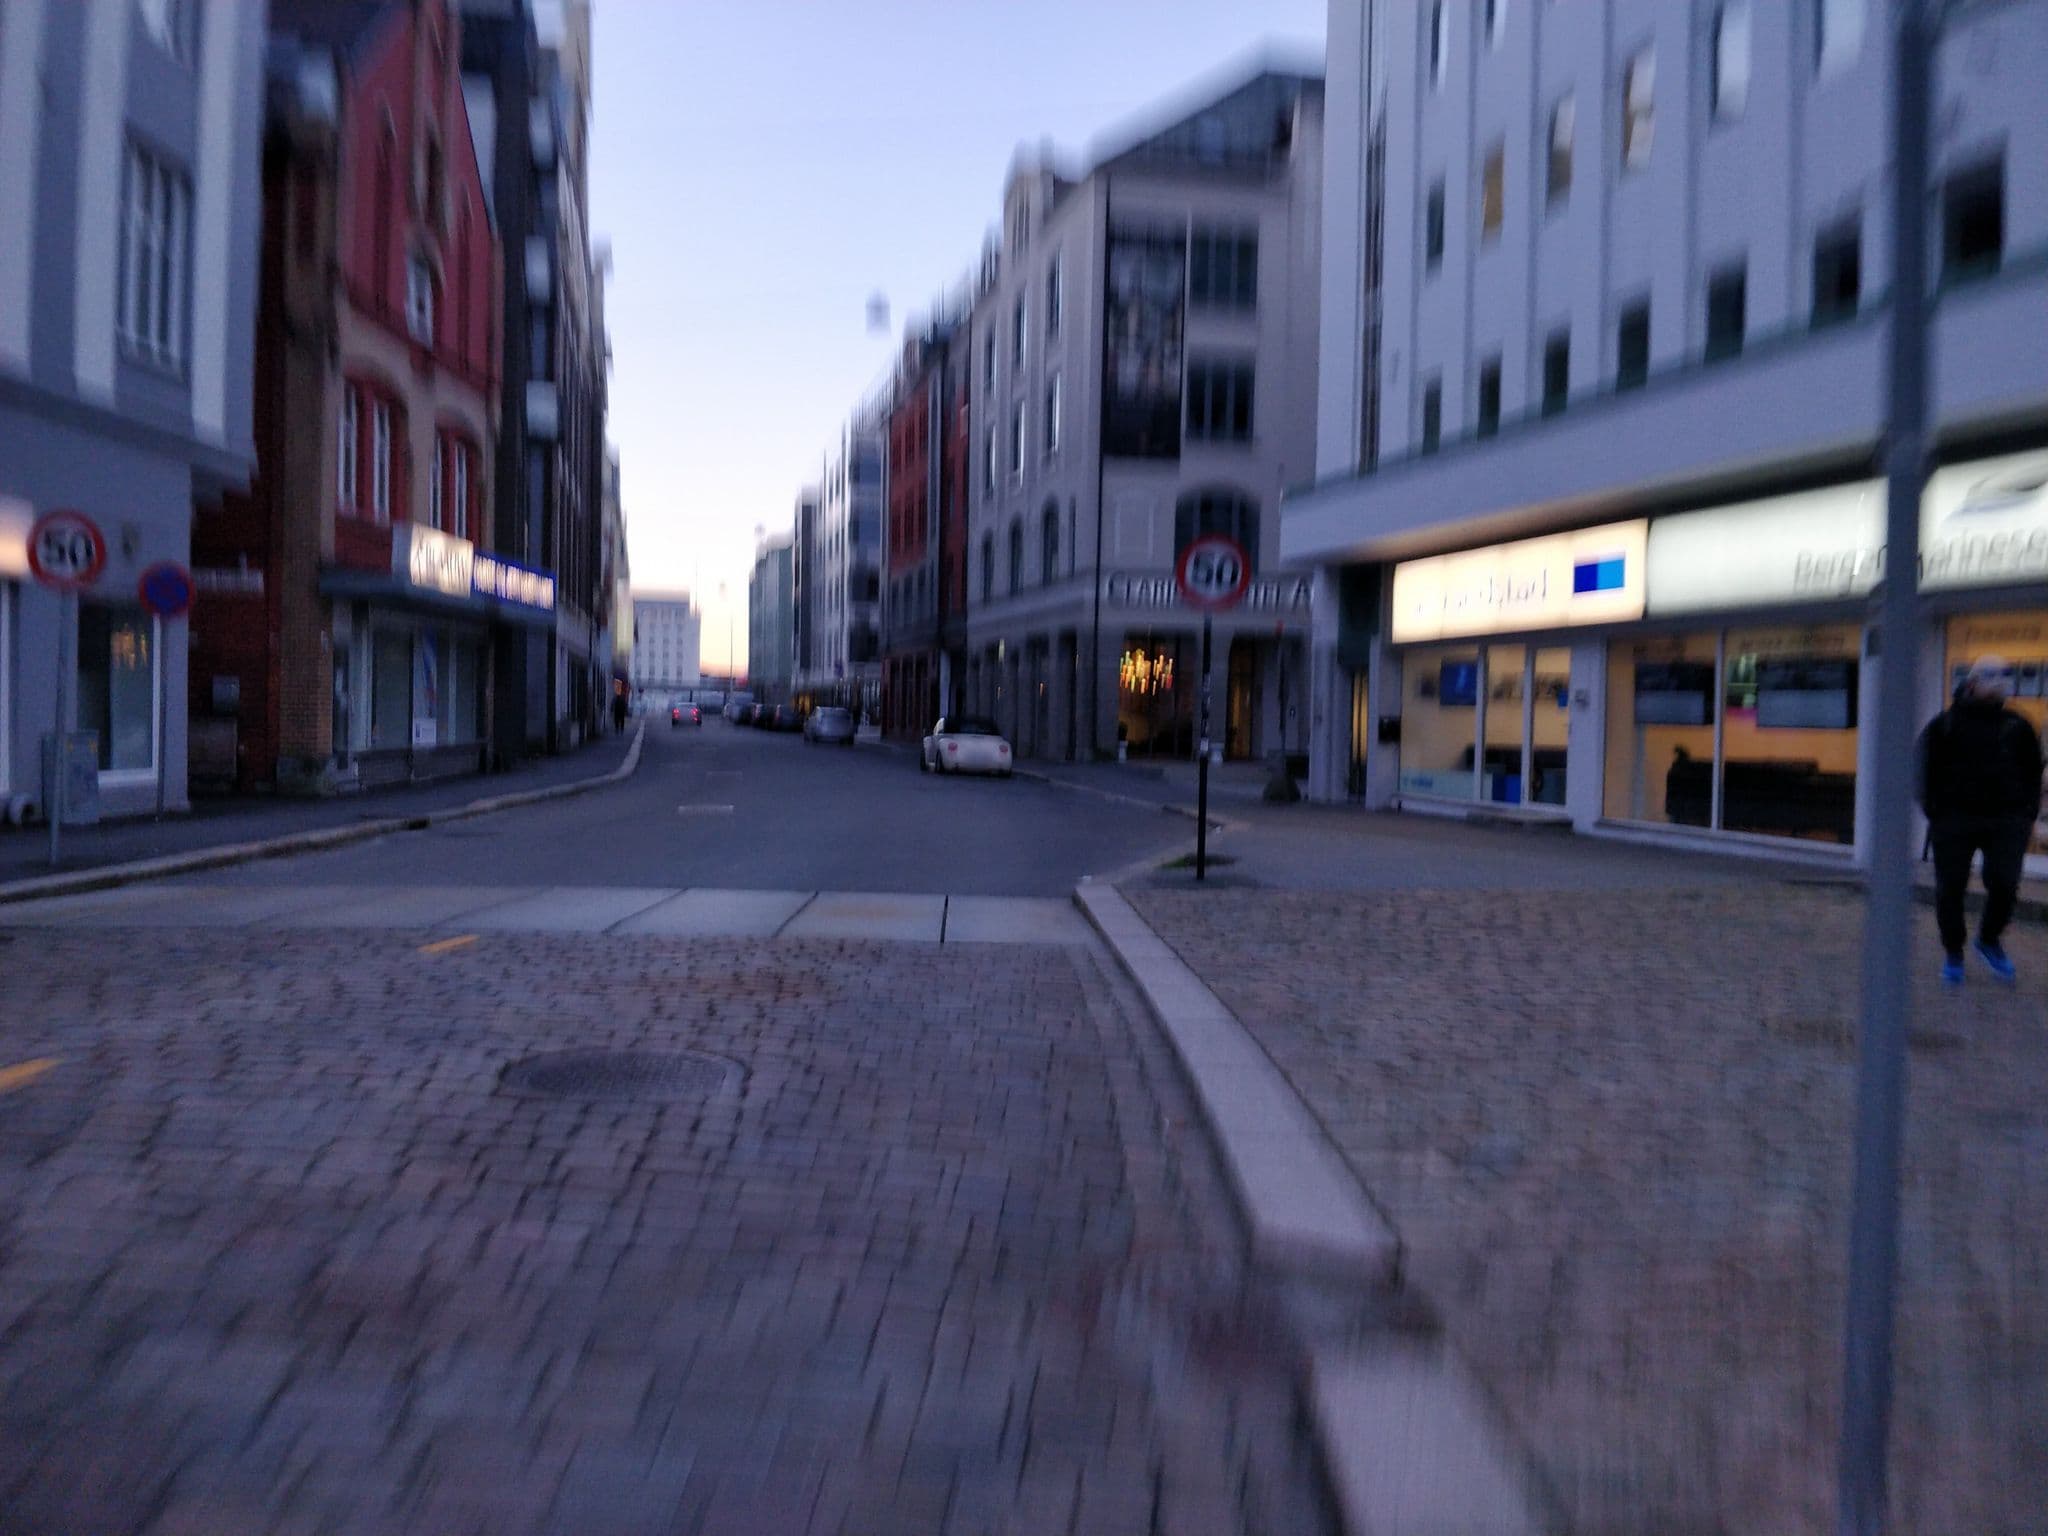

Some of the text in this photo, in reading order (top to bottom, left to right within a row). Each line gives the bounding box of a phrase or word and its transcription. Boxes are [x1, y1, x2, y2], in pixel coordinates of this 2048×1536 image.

[43, 526, 94, 570] 50
[1106, 569, 1176, 609] CLARI
[1191, 549, 1241, 590] 50
[1793, 546, 1876, 597] Berge
